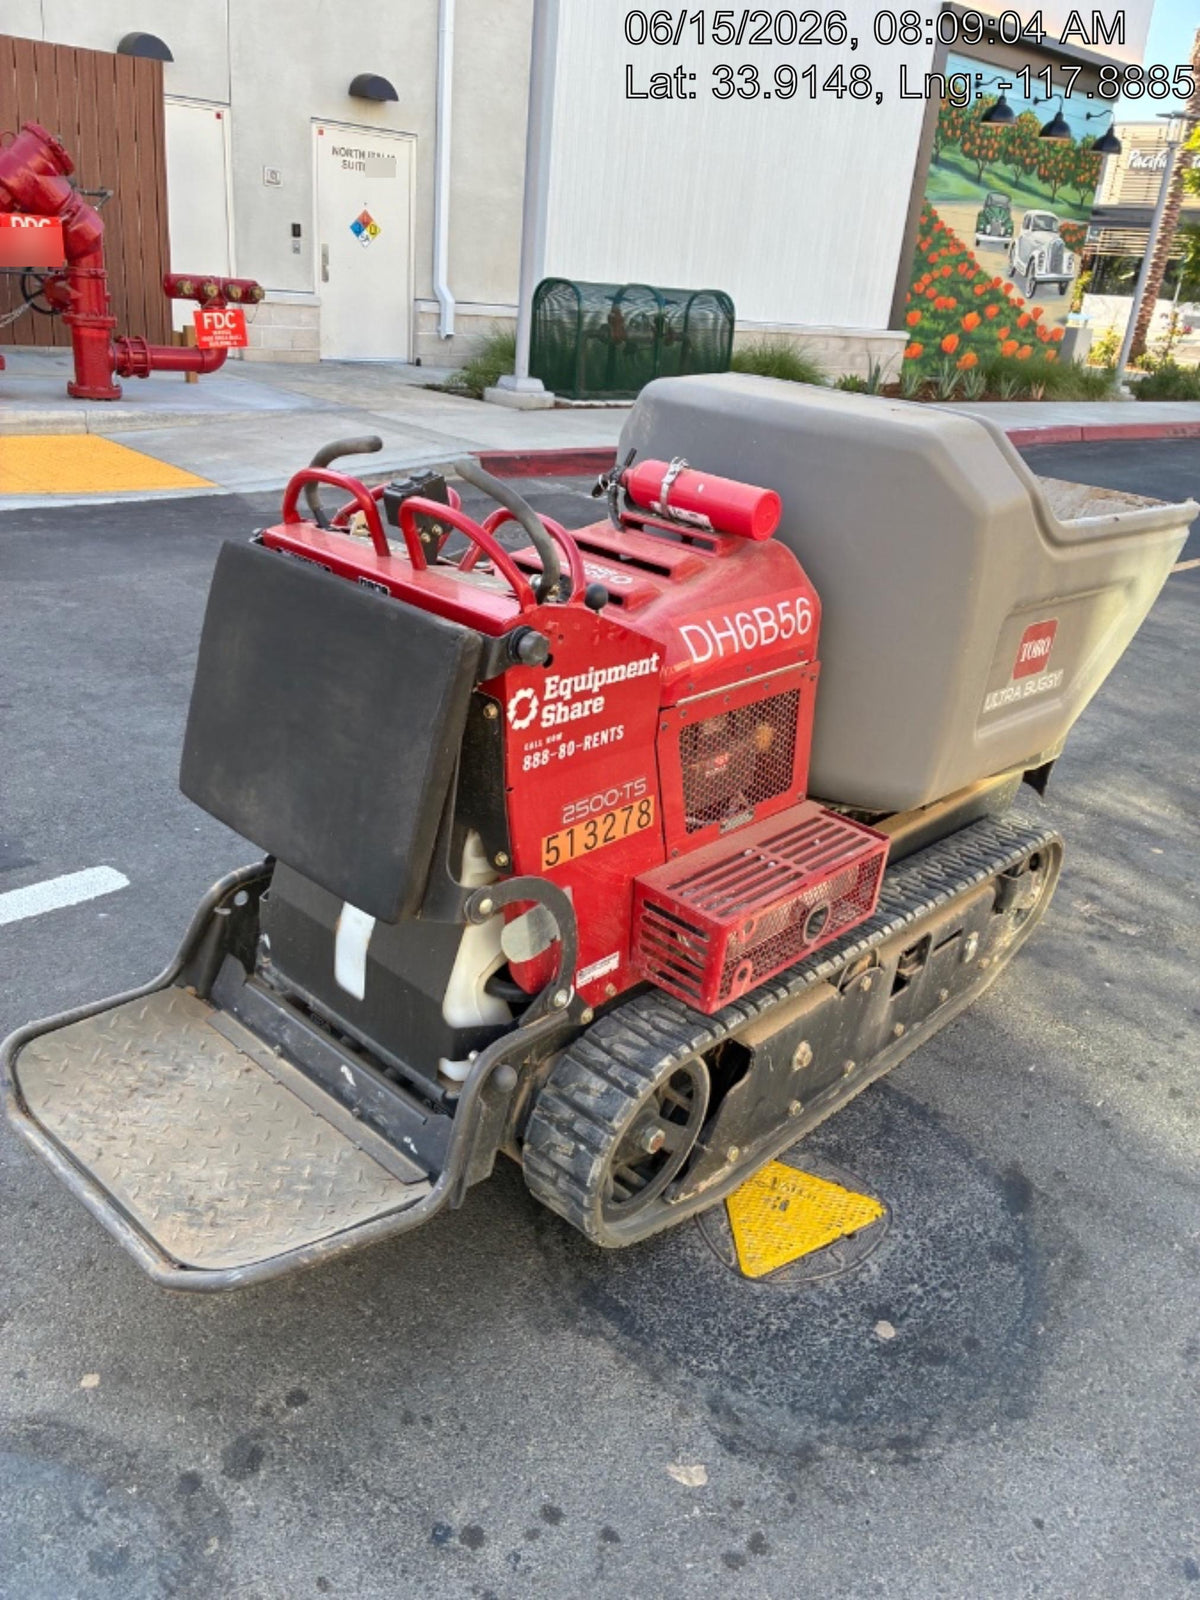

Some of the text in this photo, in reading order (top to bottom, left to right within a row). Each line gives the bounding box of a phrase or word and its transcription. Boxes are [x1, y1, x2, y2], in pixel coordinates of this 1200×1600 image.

[332, 145, 365, 159] NORTH
[341, 159, 366, 172] SUIT
[1128, 148, 1168, 171] Pacifi
[203, 311, 237, 329] FDC
[679, 596, 812, 664] DH6B56
[543, 652, 660, 701] Equipment
[982, 668, 1064, 714] ULTRA BUGGY
[540, 696, 605, 728] Share
[522, 724, 625, 771] 888-80-RENTS
[545, 798, 652, 867] 513278
